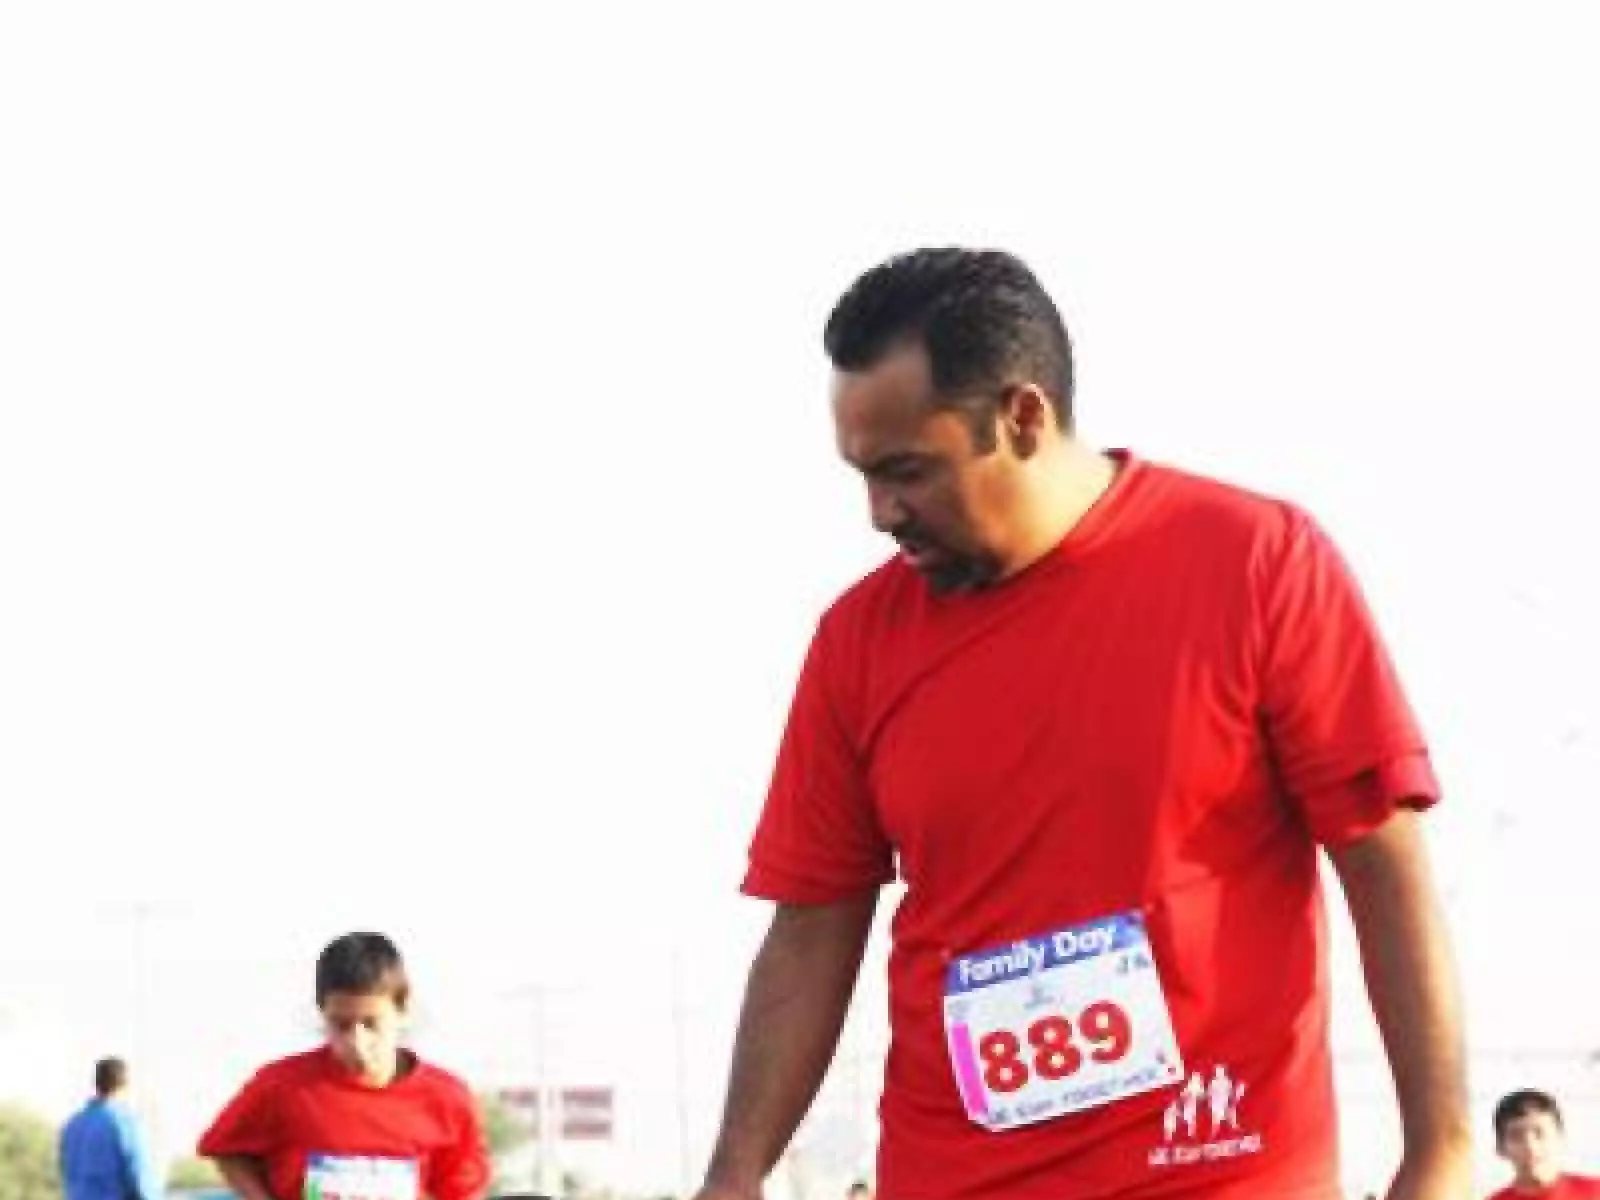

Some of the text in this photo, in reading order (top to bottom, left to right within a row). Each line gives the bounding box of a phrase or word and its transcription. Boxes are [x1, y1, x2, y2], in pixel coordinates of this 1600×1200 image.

[959, 926, 1118, 985] Family Day
[979, 1000, 1134, 1092] 889
